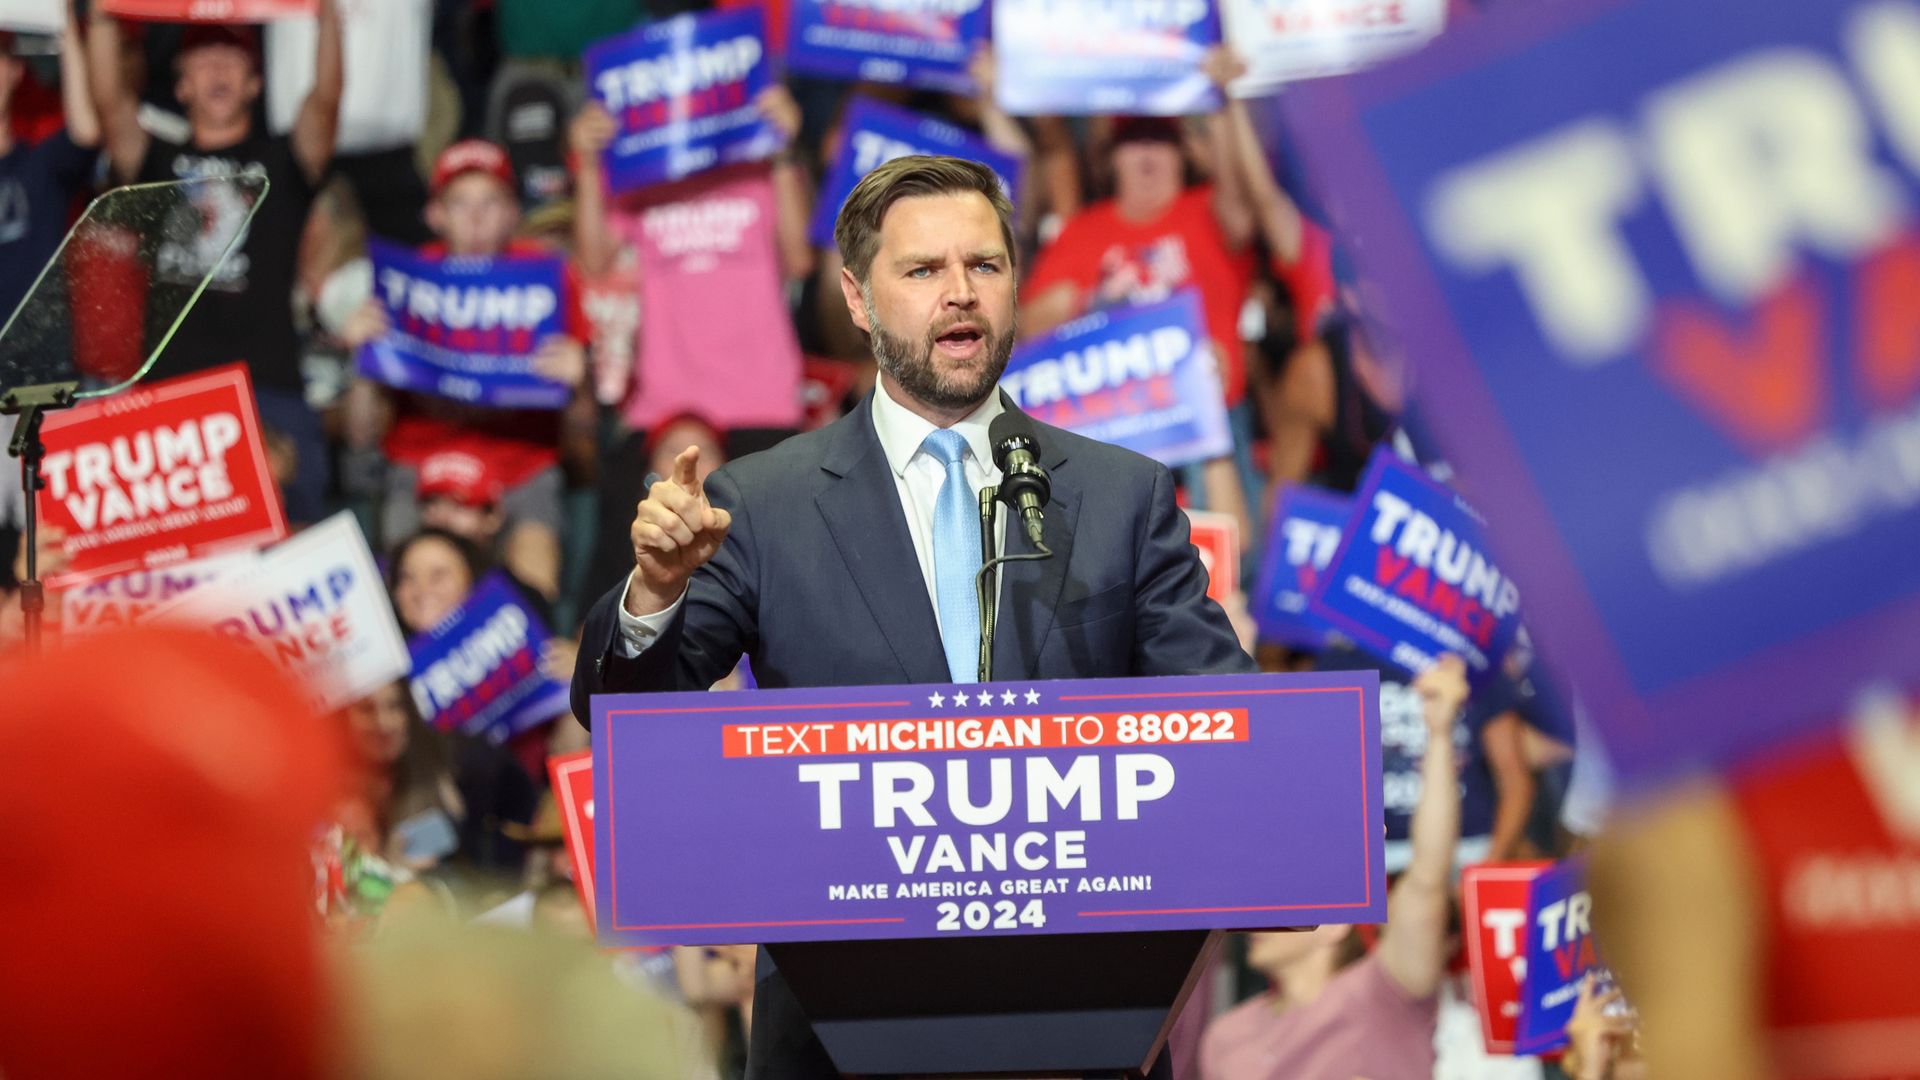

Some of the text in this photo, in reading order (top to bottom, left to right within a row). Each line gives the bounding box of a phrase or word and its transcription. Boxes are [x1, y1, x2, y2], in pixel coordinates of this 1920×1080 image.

[41, 411, 242, 500] TRUMP
[64, 460, 234, 533] VANCE
[1370, 488, 1520, 620] TRUMP
[736, 711, 1236, 755] TEXT MICHIGAN TO 88022
[798, 752, 1177, 830] TRUMP
[886, 829, 1088, 875] VANCE
[828, 874, 1153, 901] MAKE AMERICA GREAT AGAIN!
[936, 898, 1048, 931] 2024
